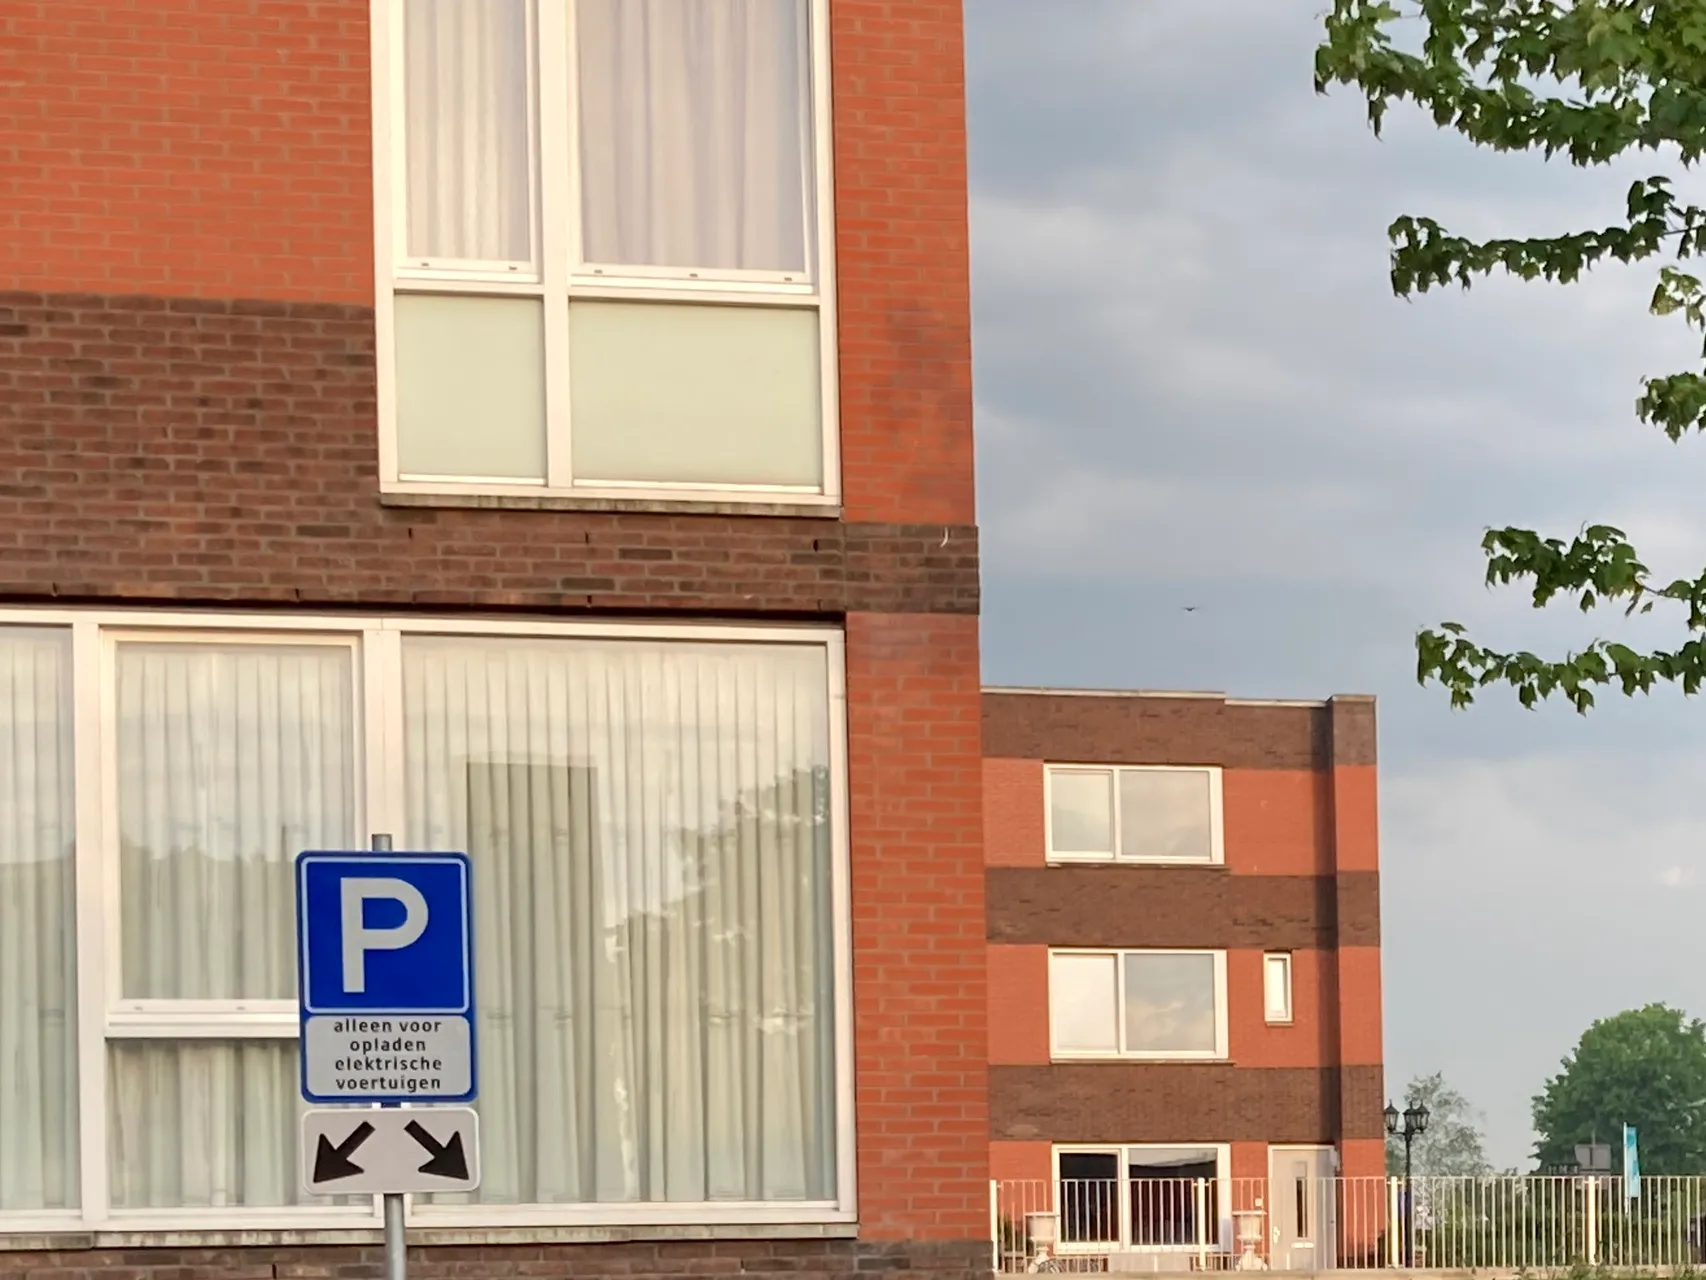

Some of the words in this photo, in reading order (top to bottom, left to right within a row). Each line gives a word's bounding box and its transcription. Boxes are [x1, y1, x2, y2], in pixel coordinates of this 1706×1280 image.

[340, 876, 429, 993] P
[334, 1018, 392, 1033] alleen
[399, 1021, 442, 1033] voor
[350, 1037, 426, 1055] opladen
[335, 1056, 442, 1071] elektrische
[336, 1075, 441, 1093] voertuigen
